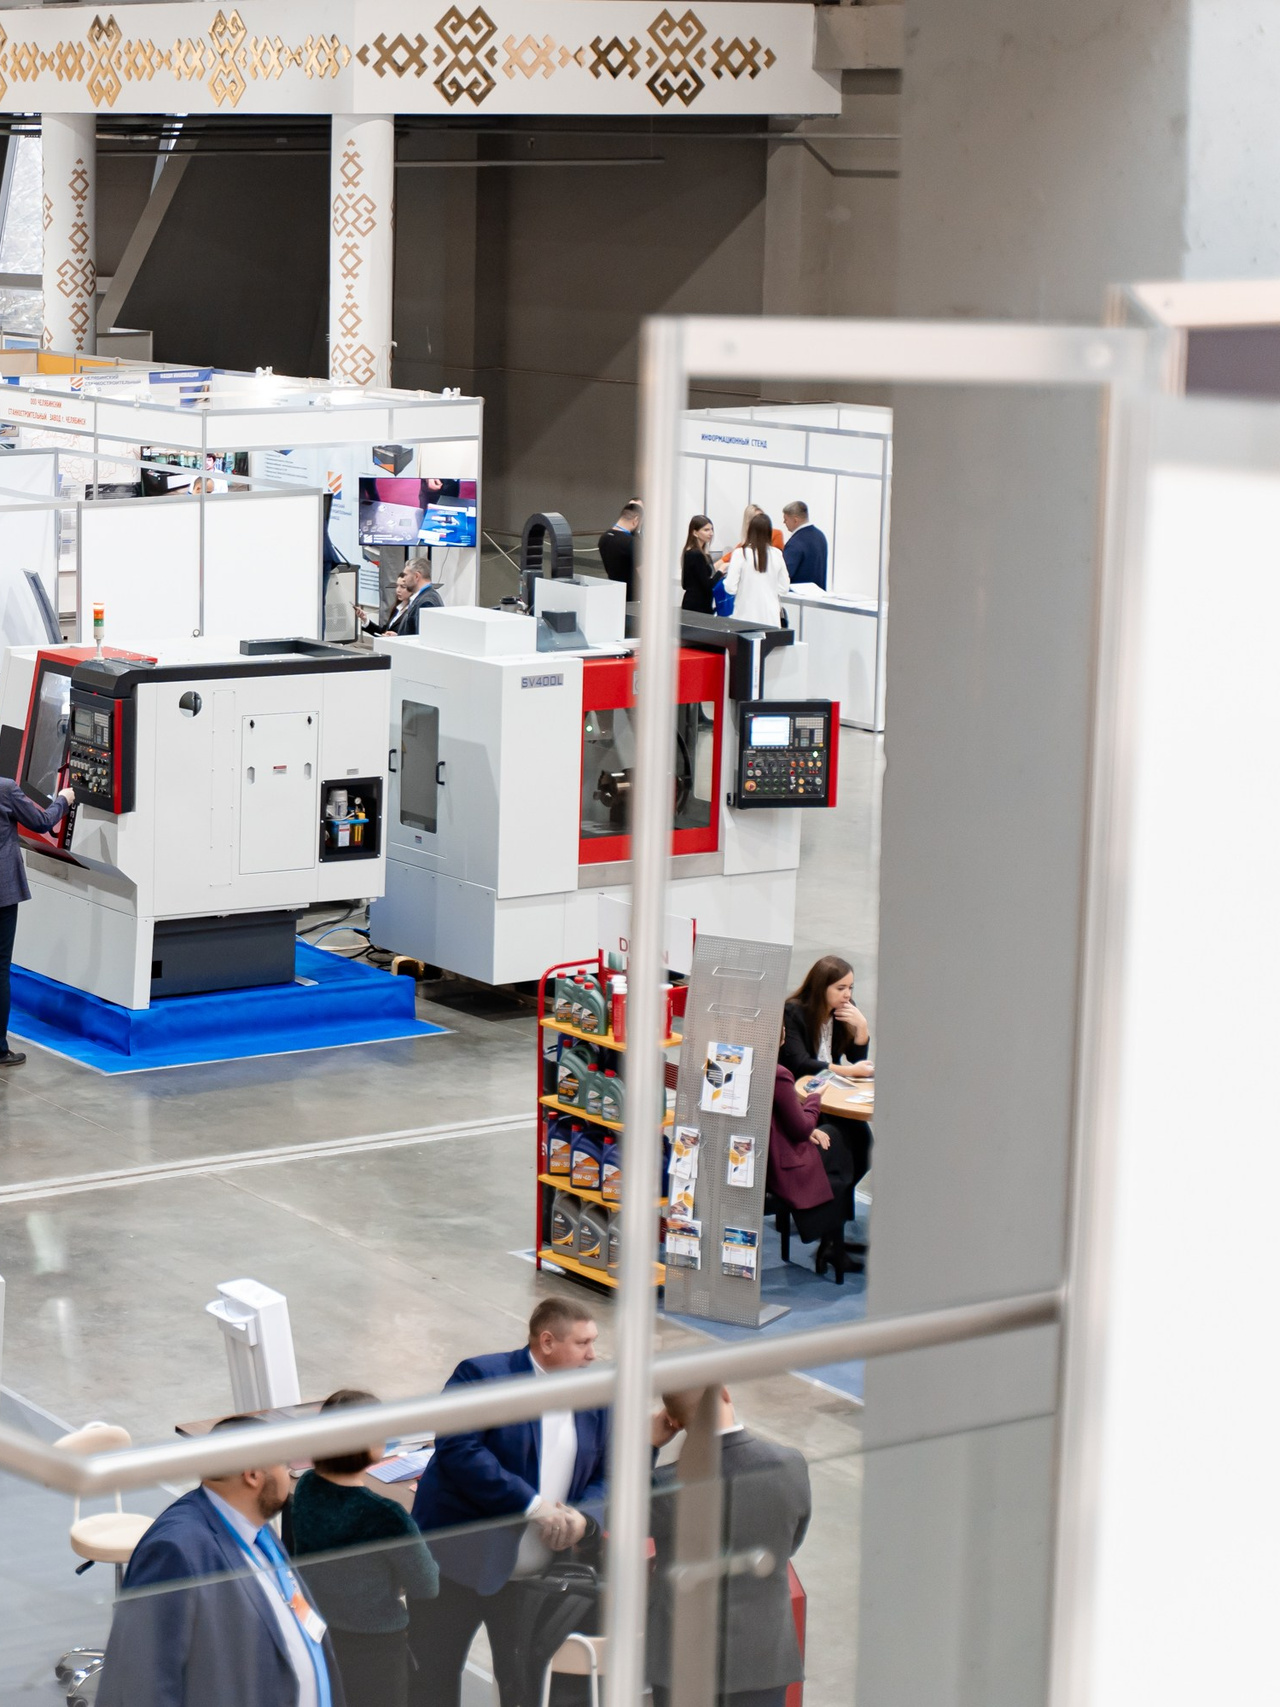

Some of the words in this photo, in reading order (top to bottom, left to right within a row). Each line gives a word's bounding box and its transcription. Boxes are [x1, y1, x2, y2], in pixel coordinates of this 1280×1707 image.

[38, 399, 62, 408] ЧЕЛЯБИНСКИЙ
[50, 414, 62, 422] ЗАВОД
[66, 416, 86, 426] ЧЕЛЯБИНСК
[701, 434, 750, 446] ИНФОРМАЦИОННЫЙ
[751, 438, 768, 448] СТЕНД
[522, 676, 563, 688] SV400L
